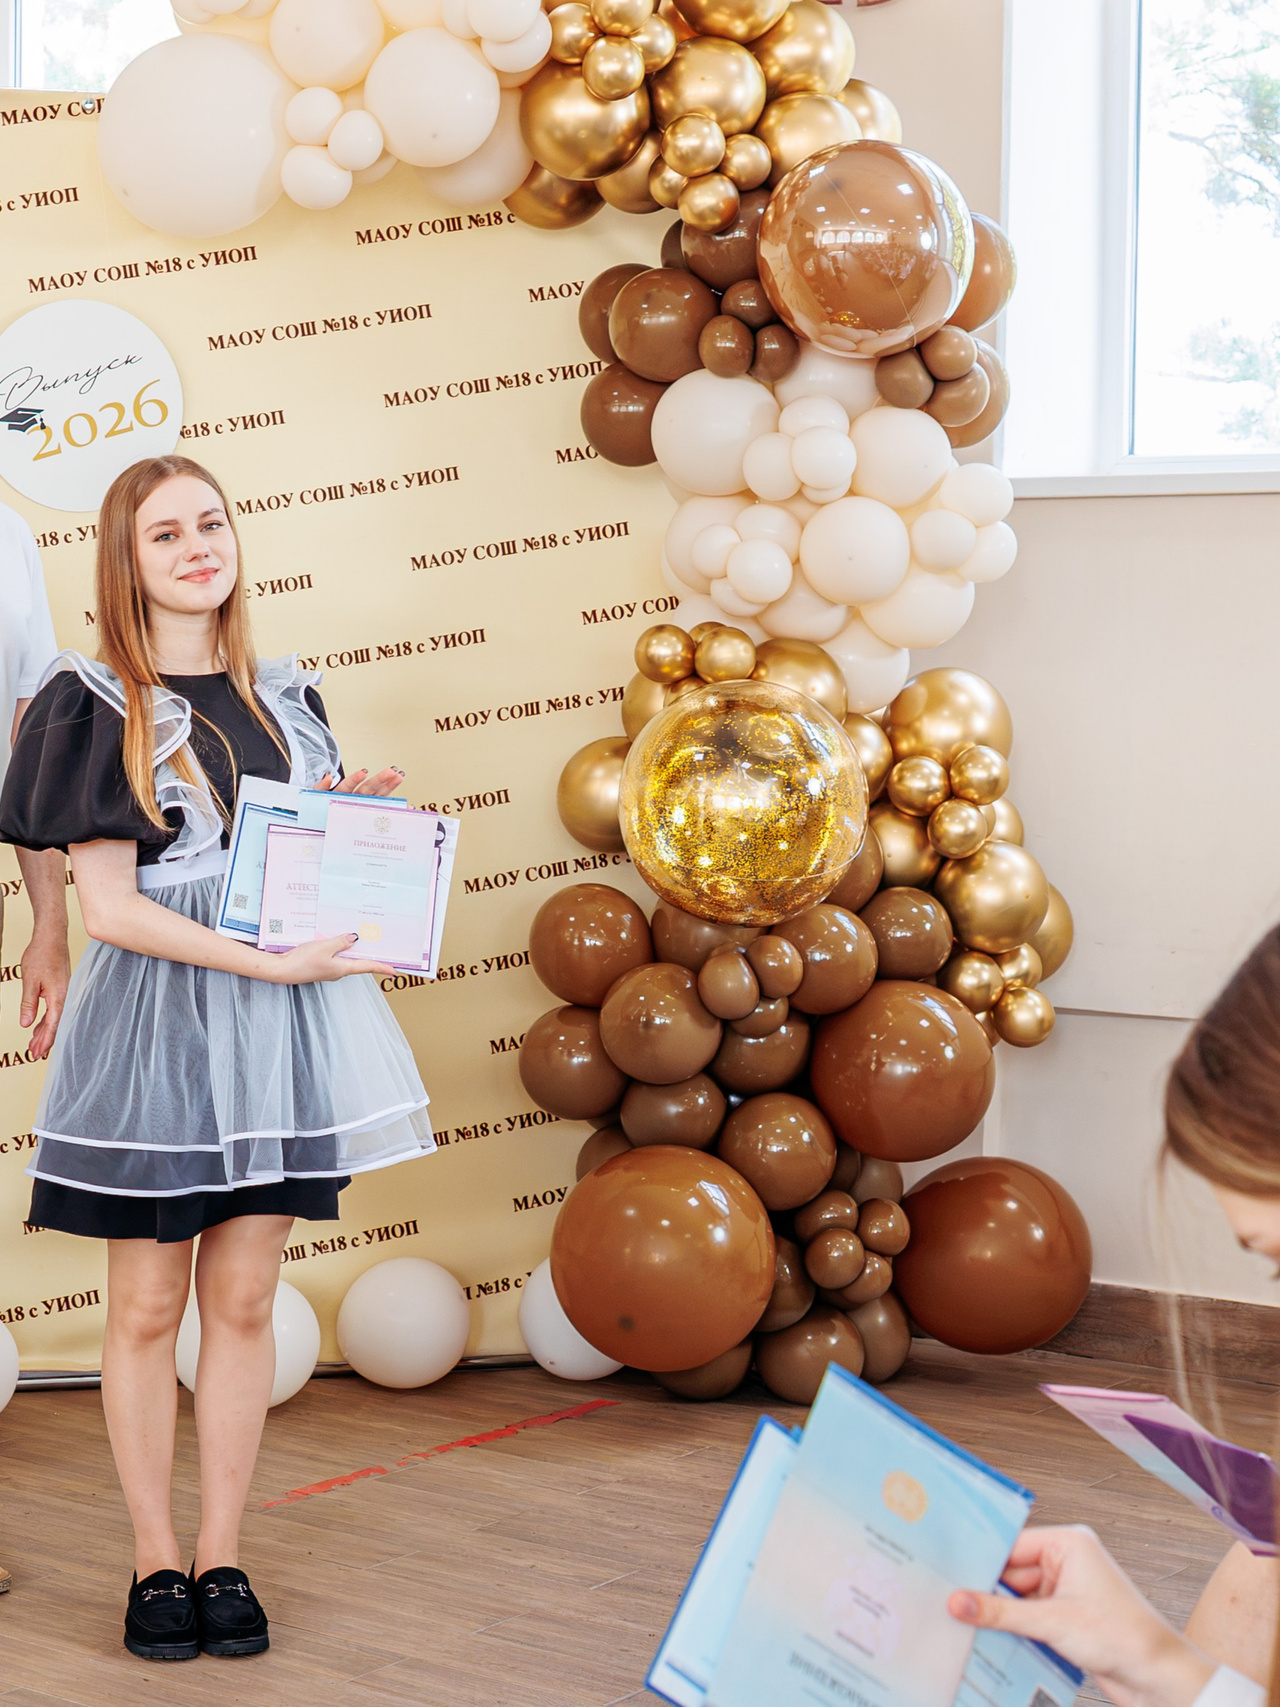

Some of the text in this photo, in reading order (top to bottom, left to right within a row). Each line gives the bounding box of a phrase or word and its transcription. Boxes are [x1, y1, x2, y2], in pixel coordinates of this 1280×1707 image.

[1, 104, 61, 125] МАОУ
[7, 201, 15, 210] с
[20, 187, 78, 208] УИОП
[357, 211, 517, 245] МАОУ СОШ №18 с
[29, 246, 257, 293] МАОУ СОШ №18 с УИОП
[528, 281, 585, 303] МАОУ
[208, 304, 432, 350] МАОУ СОШ №18 с УИОП
[384, 361, 604, 407] МАОУ СОШ №18 с УИОП
[26, 378, 169, 461] 2026
[215, 424, 223, 434] с
[228, 410, 285, 432] УИОП
[555, 445, 599, 465] МАО
[236, 467, 459, 514] МАОУ СОШ №18 с УИОП
[64, 533, 72, 543] с
[411, 522, 629, 571] МАОУ СОШ №18 с УИОП
[255, 574, 312, 596] УИОП
[582, 603, 636, 625] МАОУ
[326, 648, 371, 668] СОШ
[376, 642, 412, 660] №18
[417, 643, 425, 653] с
[429, 629, 485, 651] УИОП
[435, 686, 625, 732] МАОУ СОШ №18 с УИ
[442, 804, 450, 814] с
[454, 789, 510, 812] УИОП
[353, 839, 407, 853] ПРИЛОЖЕНИЕ
[464, 853, 619, 894] МАОУ СОШ №18 с
[286, 882, 320, 893] АТТЕСТ
[380, 974, 425, 993] СОШ
[470, 966, 478, 975] с
[489, 1033, 527, 1055] МА
[0, 1143, 8, 1153] с
[11, 1133, 38, 1151] УИ
[454, 1123, 489, 1143] №18
[494, 1124, 502, 1134] с
[512, 1186, 569, 1212] МАОУ
[311, 1236, 347, 1256] №18
[351, 1237, 360, 1247] с
[363, 1220, 419, 1244] УИОП
[476, 1278, 510, 1298] №18
[514, 1278, 522, 1288] с
[29, 1308, 38, 1318] с
[42, 1290, 100, 1315] УИОП
